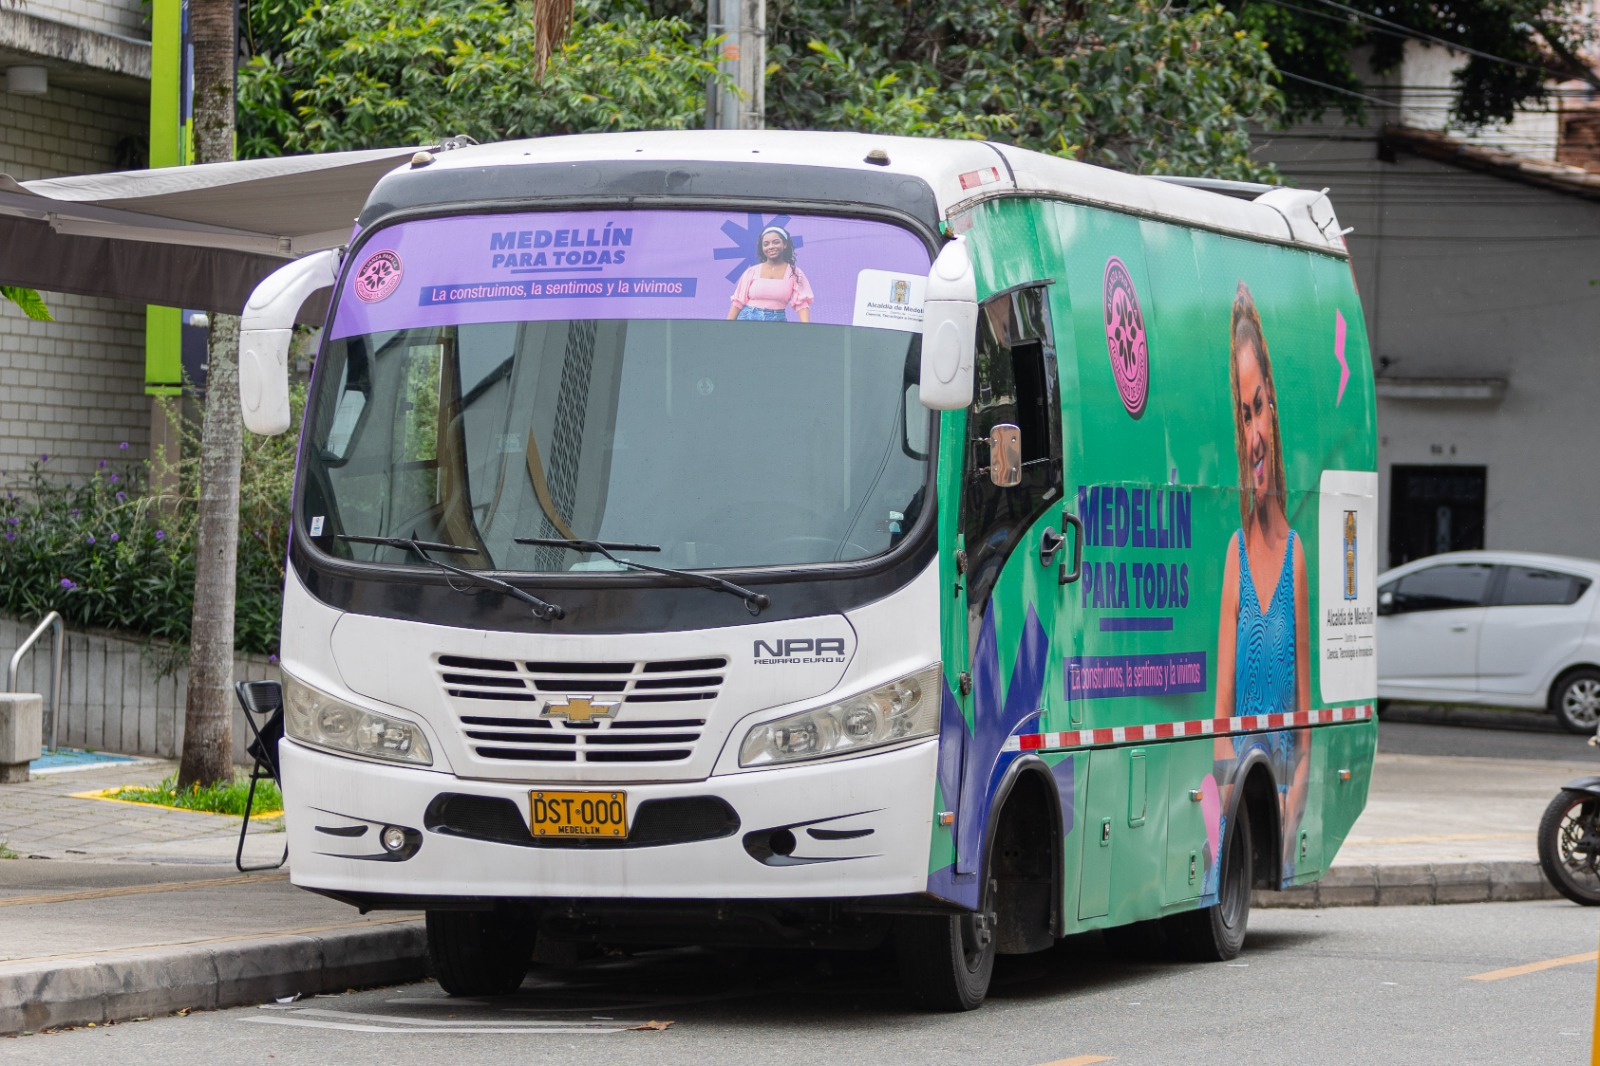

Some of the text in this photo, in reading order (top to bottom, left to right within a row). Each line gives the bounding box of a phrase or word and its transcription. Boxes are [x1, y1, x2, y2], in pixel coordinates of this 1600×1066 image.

[490, 221, 633, 250] MEDELLÍN
[492, 250, 625, 268] PARA TODAS
[432, 280, 682, 301] La construimos, la sentimos y la vivimos
[1082, 561, 1189, 609] PARA TODAS
[754, 638, 845, 657] NPR
[754, 657, 801, 665] REWARD
[803, 656, 834, 664] EURO
[1126, 660, 1132, 687] la
[1134, 660, 1163, 687] sentimos
[1164, 665, 1169, 691] y
[1170, 659, 1176, 685] la
[1177, 658, 1200, 684] vivimos
[558, 825, 600, 834] MEDELLIN
